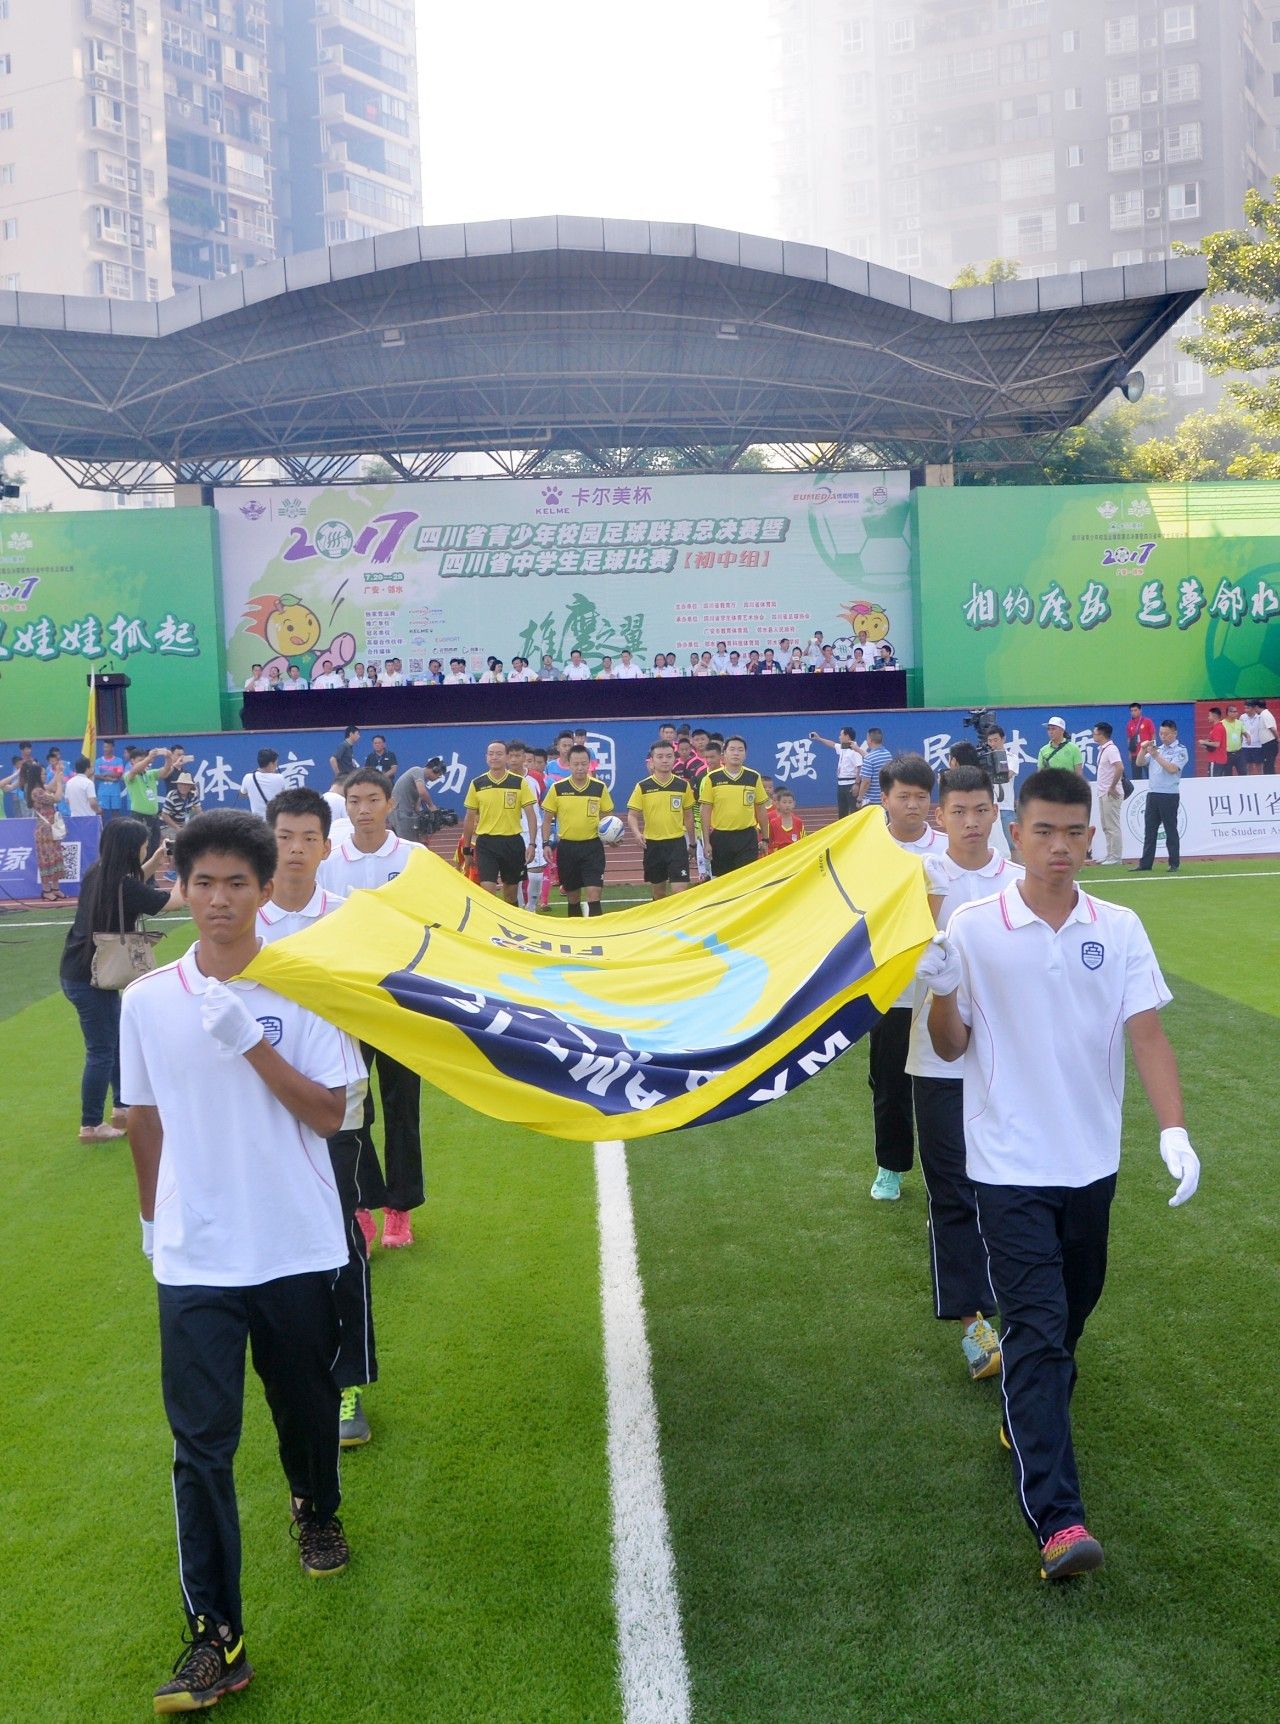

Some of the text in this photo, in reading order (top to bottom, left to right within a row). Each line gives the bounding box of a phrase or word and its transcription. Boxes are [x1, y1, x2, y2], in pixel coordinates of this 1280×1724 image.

[571, 486, 652, 507] 卡尔美杯
[793, 493, 837, 501] EUMEDIA
[535, 507, 570, 515] KELME
[283, 511, 419, 564] 2017
[416, 517, 790, 551] 四川省青少年校园足球联赛总决赛暨
[440, 547, 678, 577] 四川省中学生足球比赛
[1102, 543, 1156, 565] 2017
[0, 614, 196, 656] 娃娃抓起
[1209, 791, 1280, 817] 四川省
[1211, 829, 1230, 837] The
[1231, 827, 1266, 837] Student
[748, 1030, 852, 1102] MY
